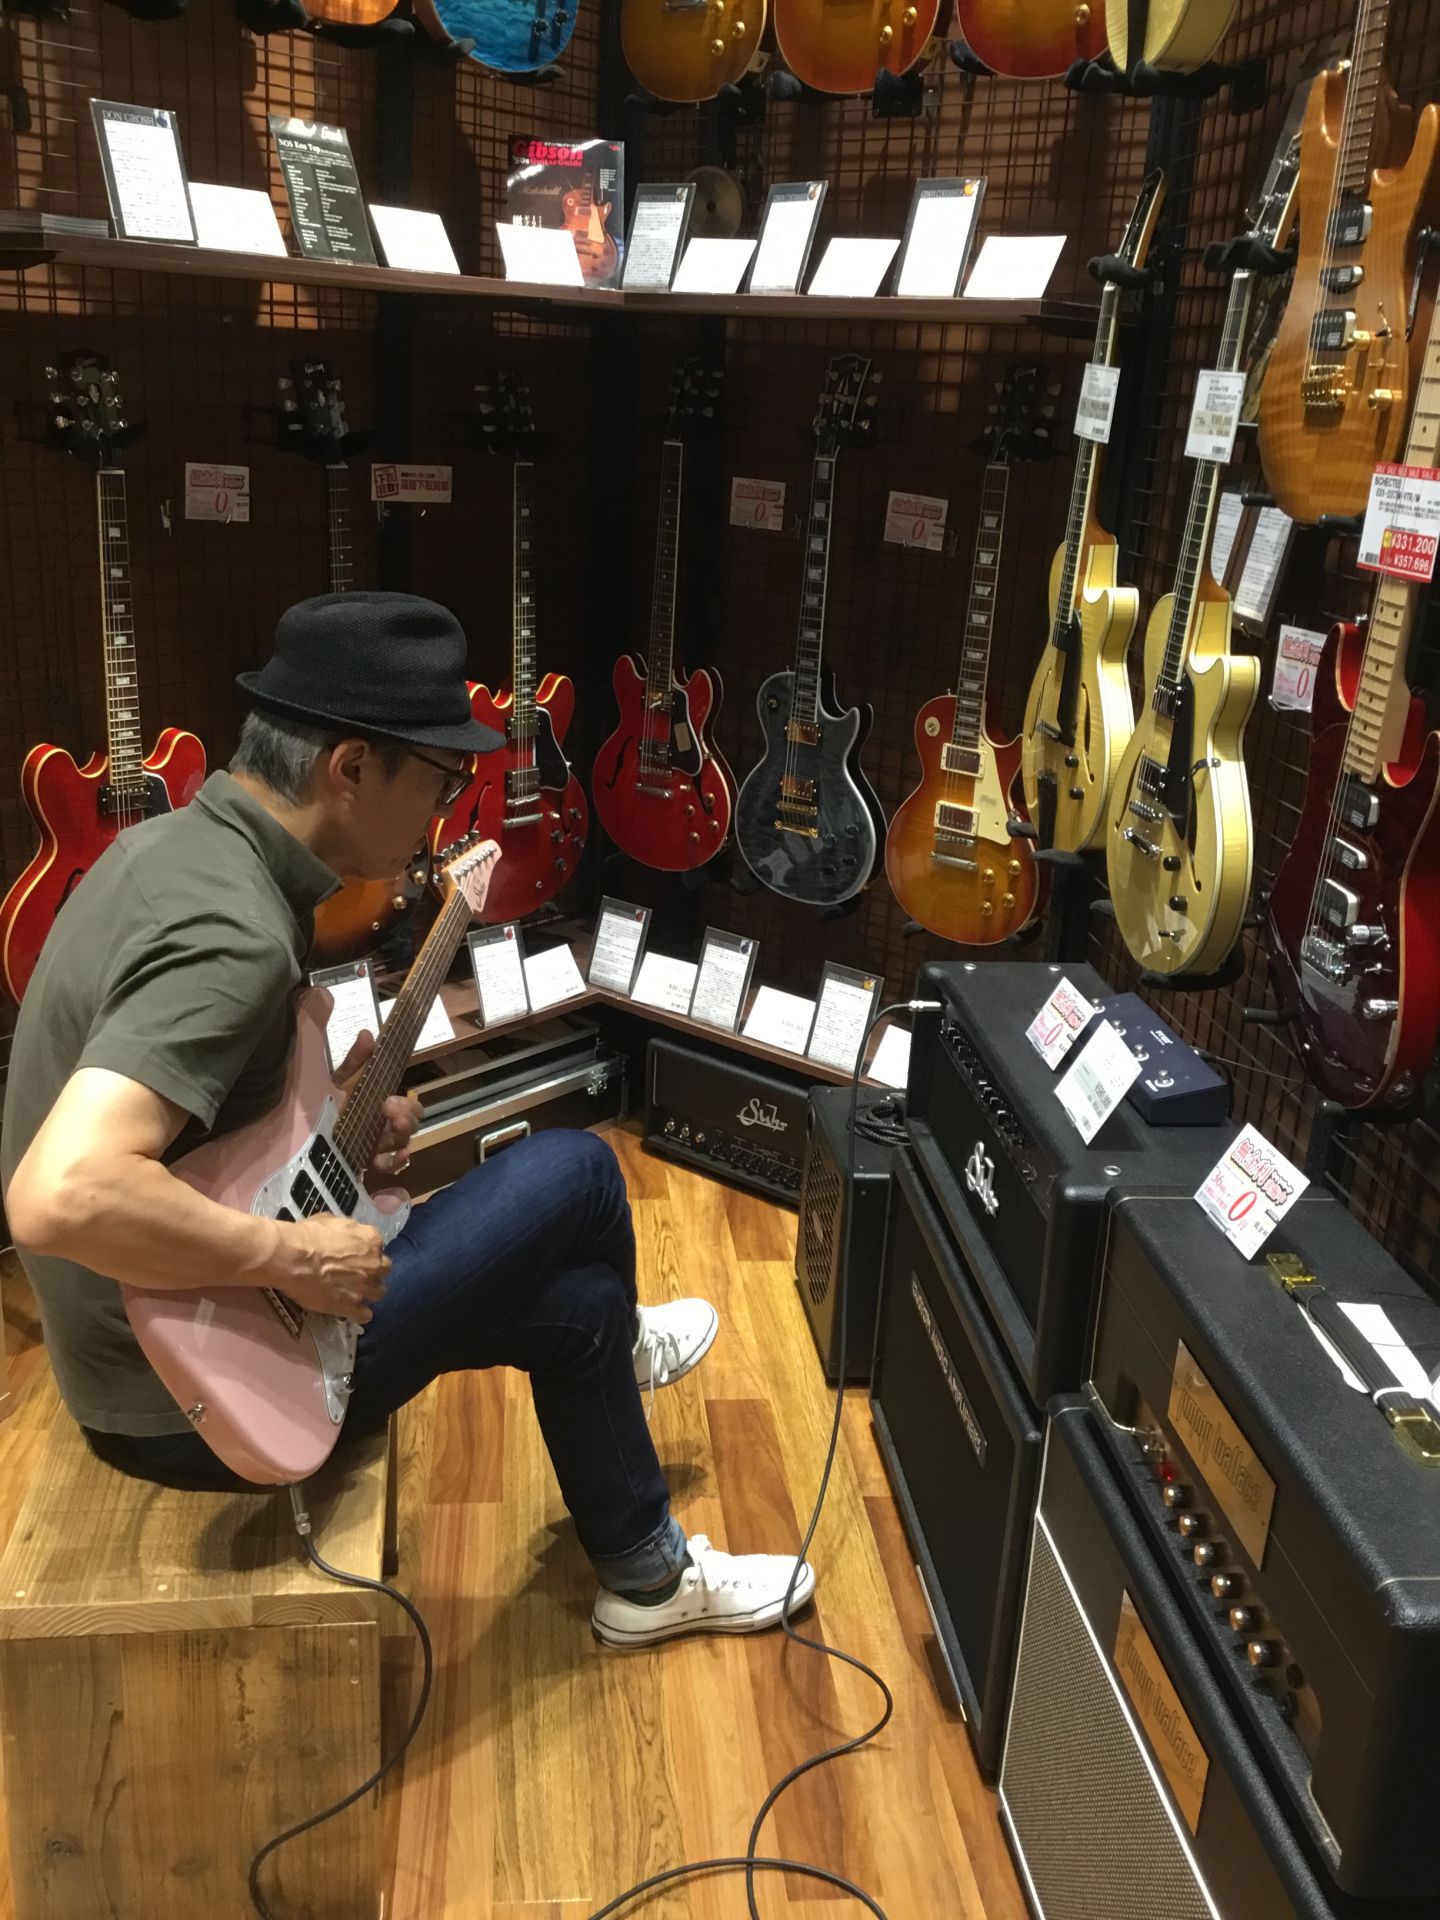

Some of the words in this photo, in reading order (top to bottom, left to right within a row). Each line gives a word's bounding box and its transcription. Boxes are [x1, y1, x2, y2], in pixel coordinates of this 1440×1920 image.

[124, 112, 155, 126] GROSH
[512, 139, 584, 161] Gibson
[736, 1098, 789, 1132] Suhr
